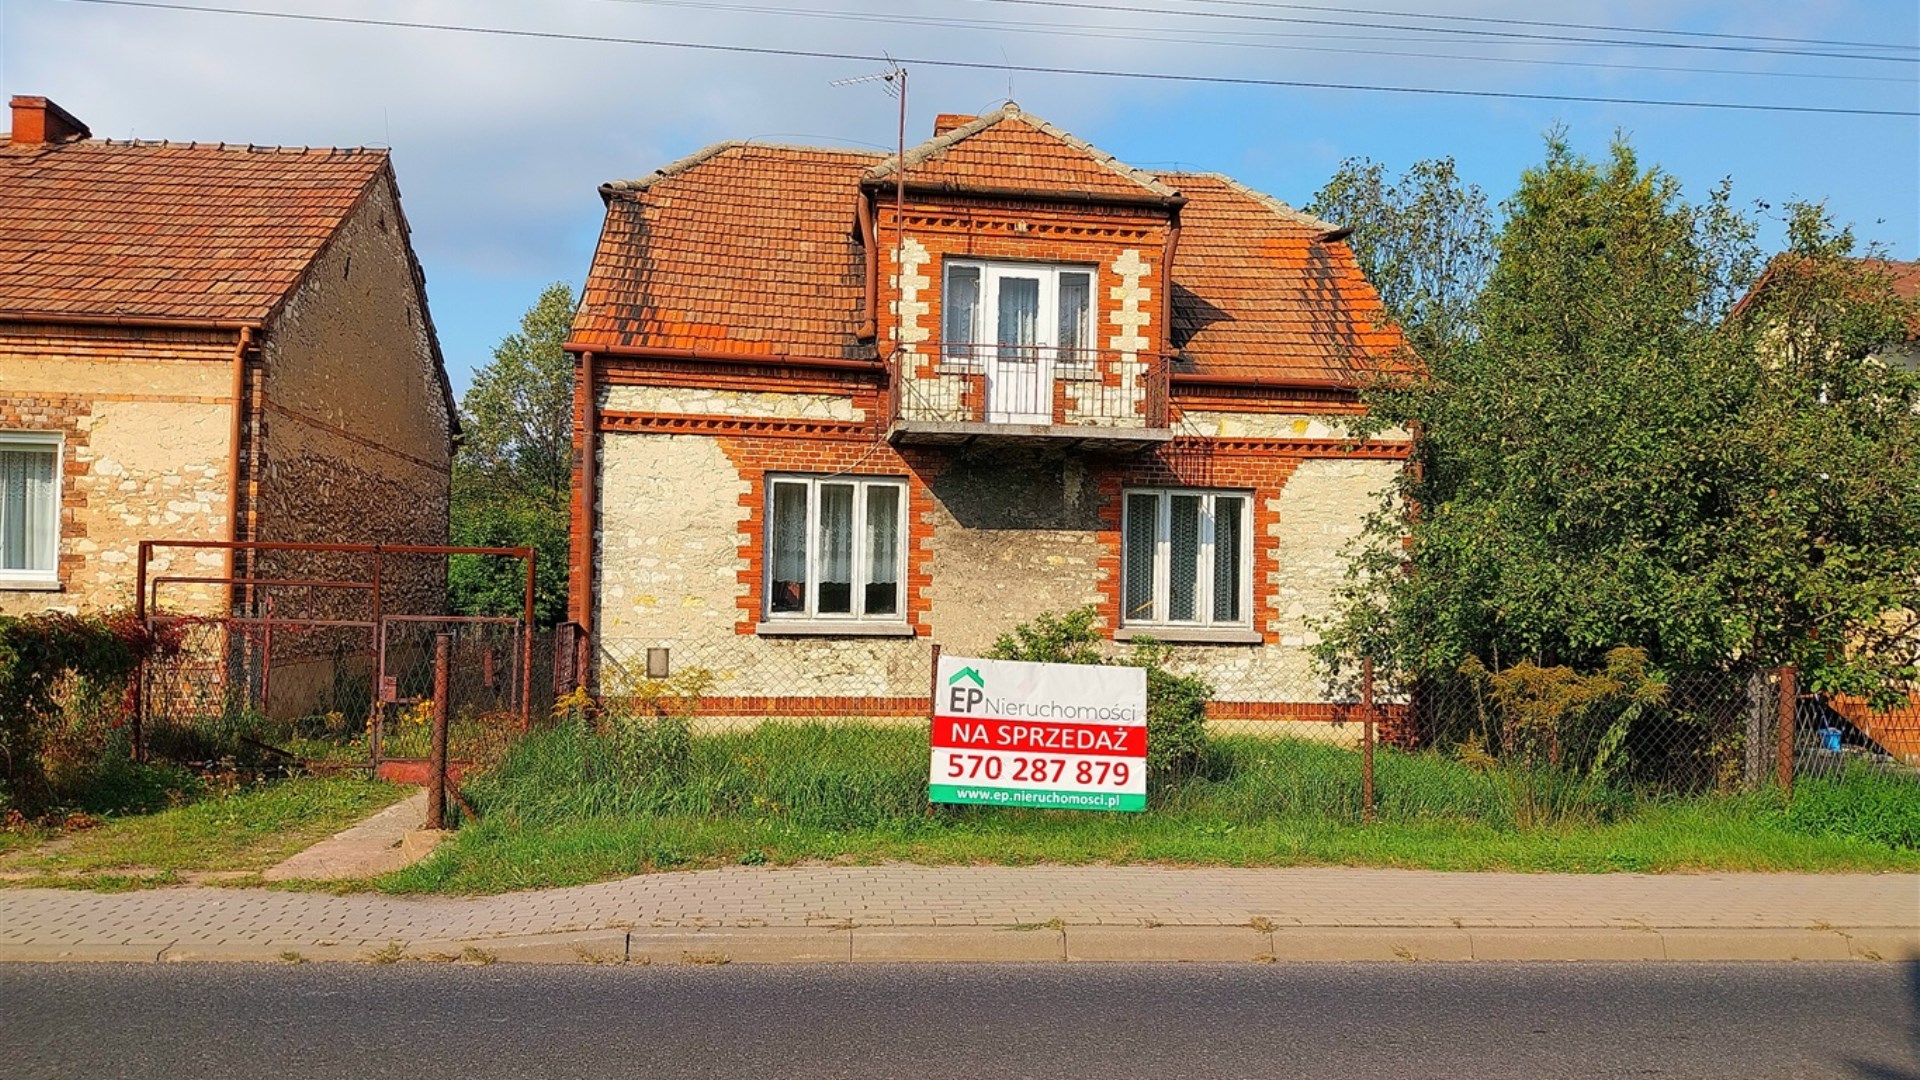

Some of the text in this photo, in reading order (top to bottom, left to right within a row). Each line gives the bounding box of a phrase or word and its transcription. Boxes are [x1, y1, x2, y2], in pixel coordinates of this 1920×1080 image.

[950, 687, 1136, 721] EP Nieruchomości
[951, 723, 1128, 751] NA SPRZEDAŻ
[948, 754, 1129, 786] 570 287 879
[957, 787, 1120, 808] www.ep.nieruchomosci.pl
